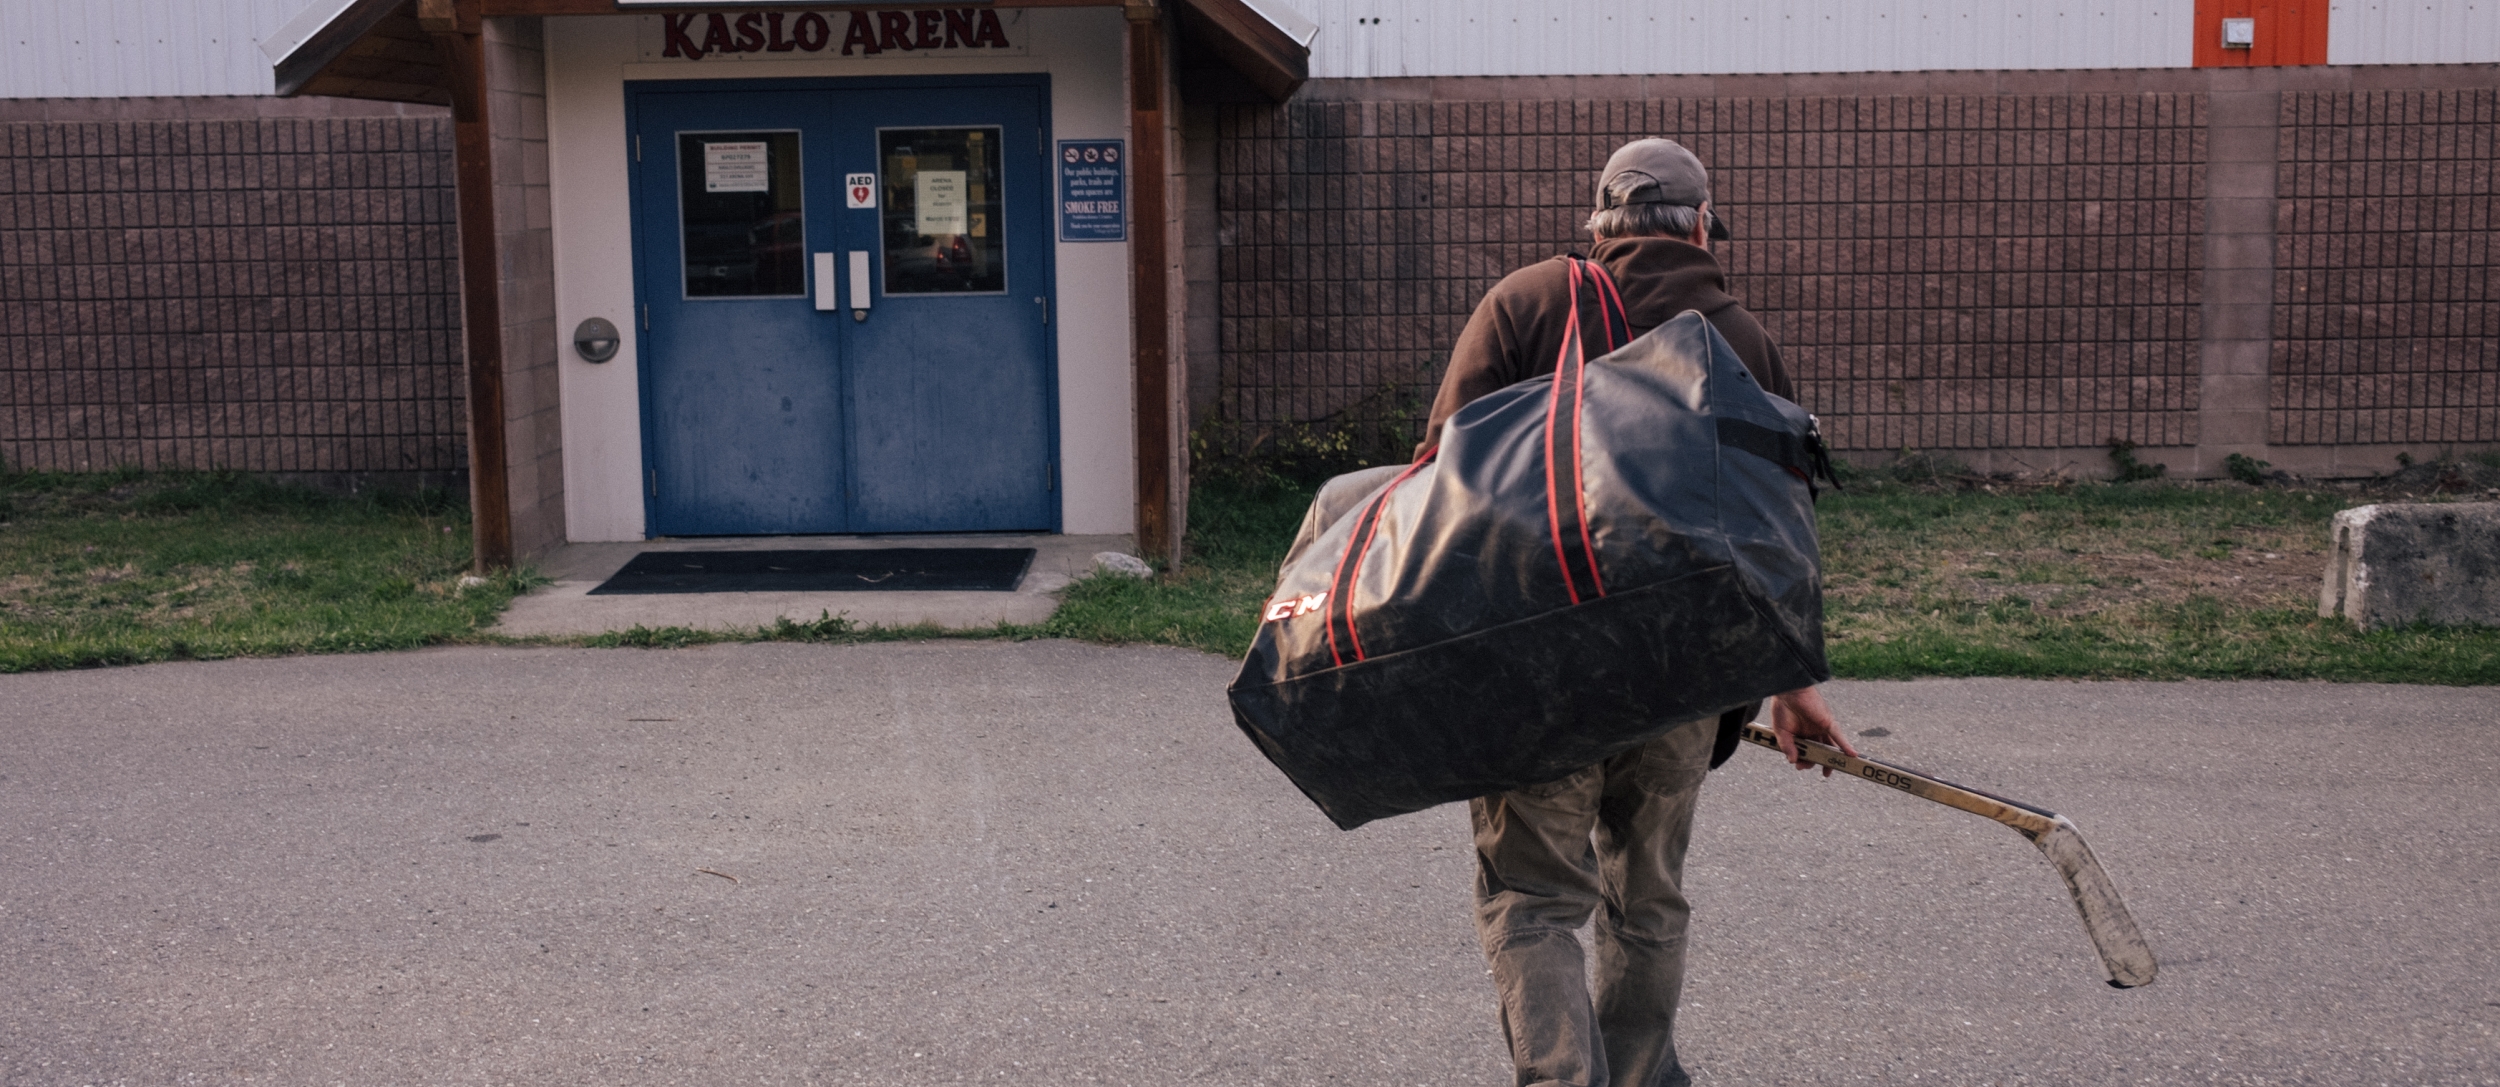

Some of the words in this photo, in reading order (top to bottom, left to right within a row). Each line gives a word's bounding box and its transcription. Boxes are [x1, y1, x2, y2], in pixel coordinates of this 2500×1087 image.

[662, 11, 830, 60] KASLO
[841, 9, 1010, 56] ARENA
[1064, 167, 1075, 176] Our
[1076, 167, 1092, 177] public
[849, 176, 873, 186] AED
[1088, 177, 1103, 186] trails
[1103, 177, 1114, 185] and
[1070, 189, 1085, 197] open
[1085, 189, 1103, 197] spaces
[1065, 201, 1096, 214] SMOKE
[1097, 200, 1120, 213] FREE
[1264, 591, 1329, 622] CM
[1862, 765, 1912, 790] 5030
